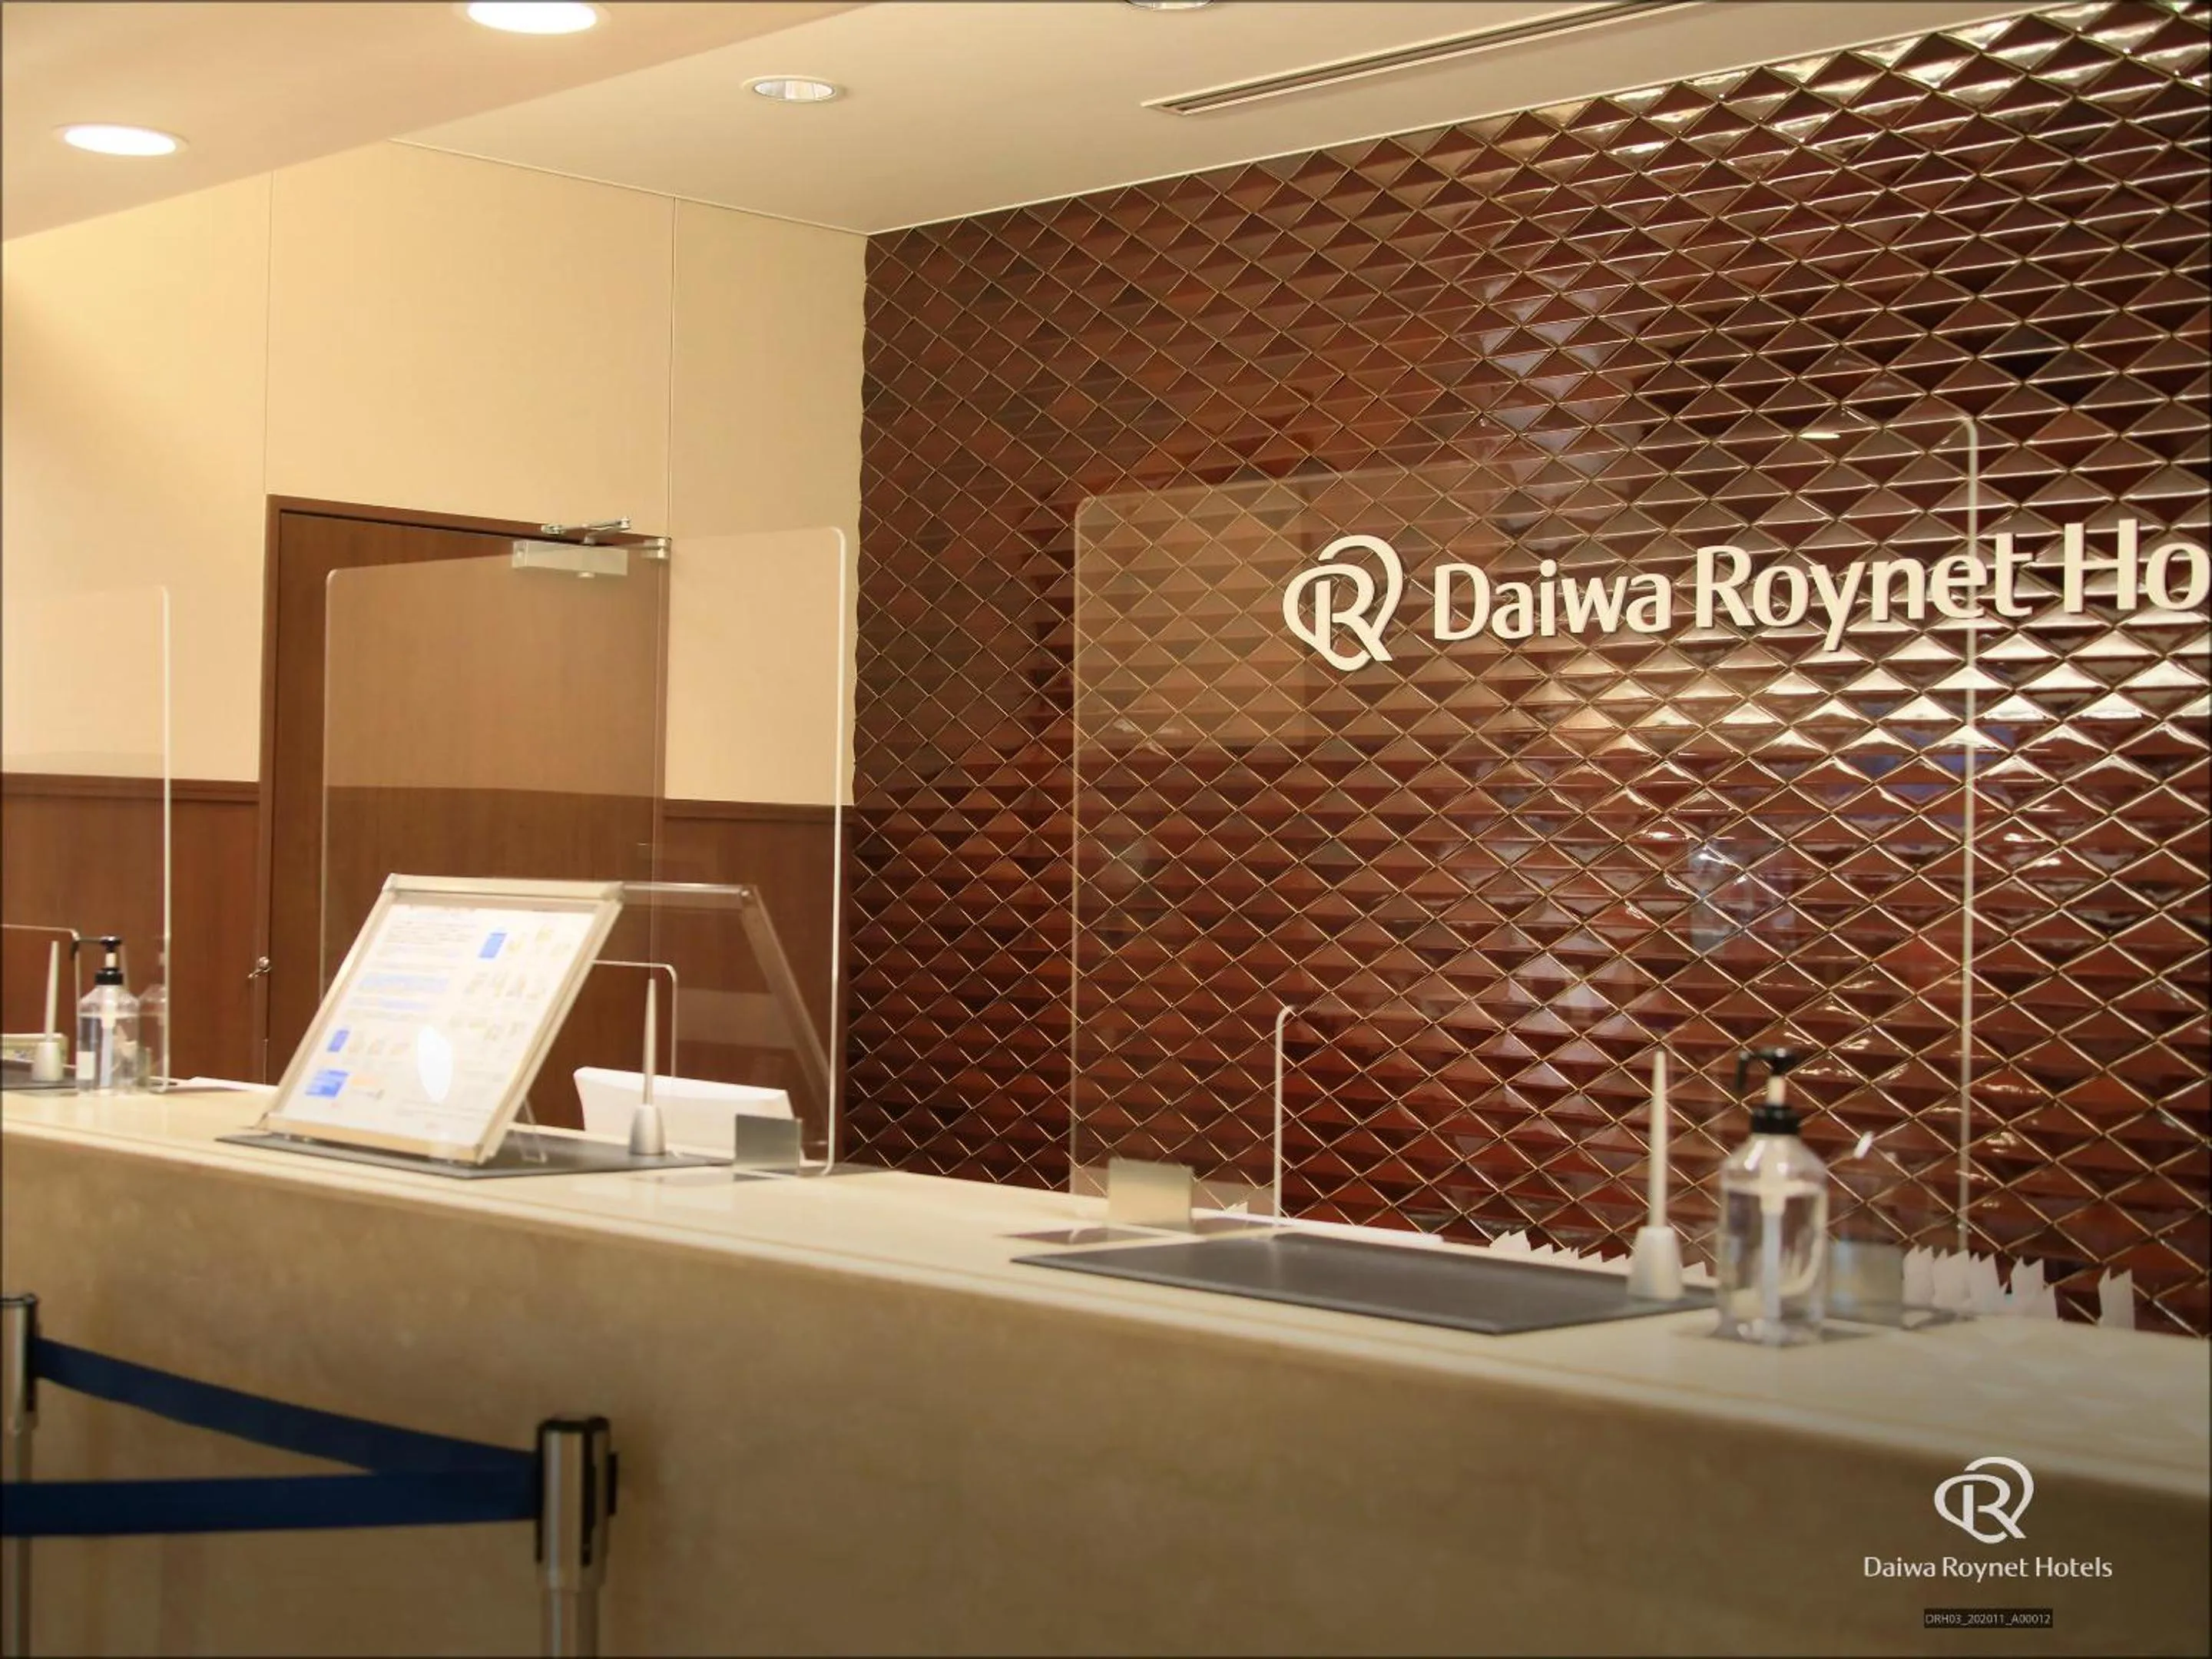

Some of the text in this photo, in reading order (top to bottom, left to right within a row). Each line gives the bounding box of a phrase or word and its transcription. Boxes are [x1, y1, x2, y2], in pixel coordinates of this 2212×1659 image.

[1433, 558, 1672, 641] Daiwa
[1696, 531, 2034, 653] Roynet
[2063, 518, 2210, 615] Ho
